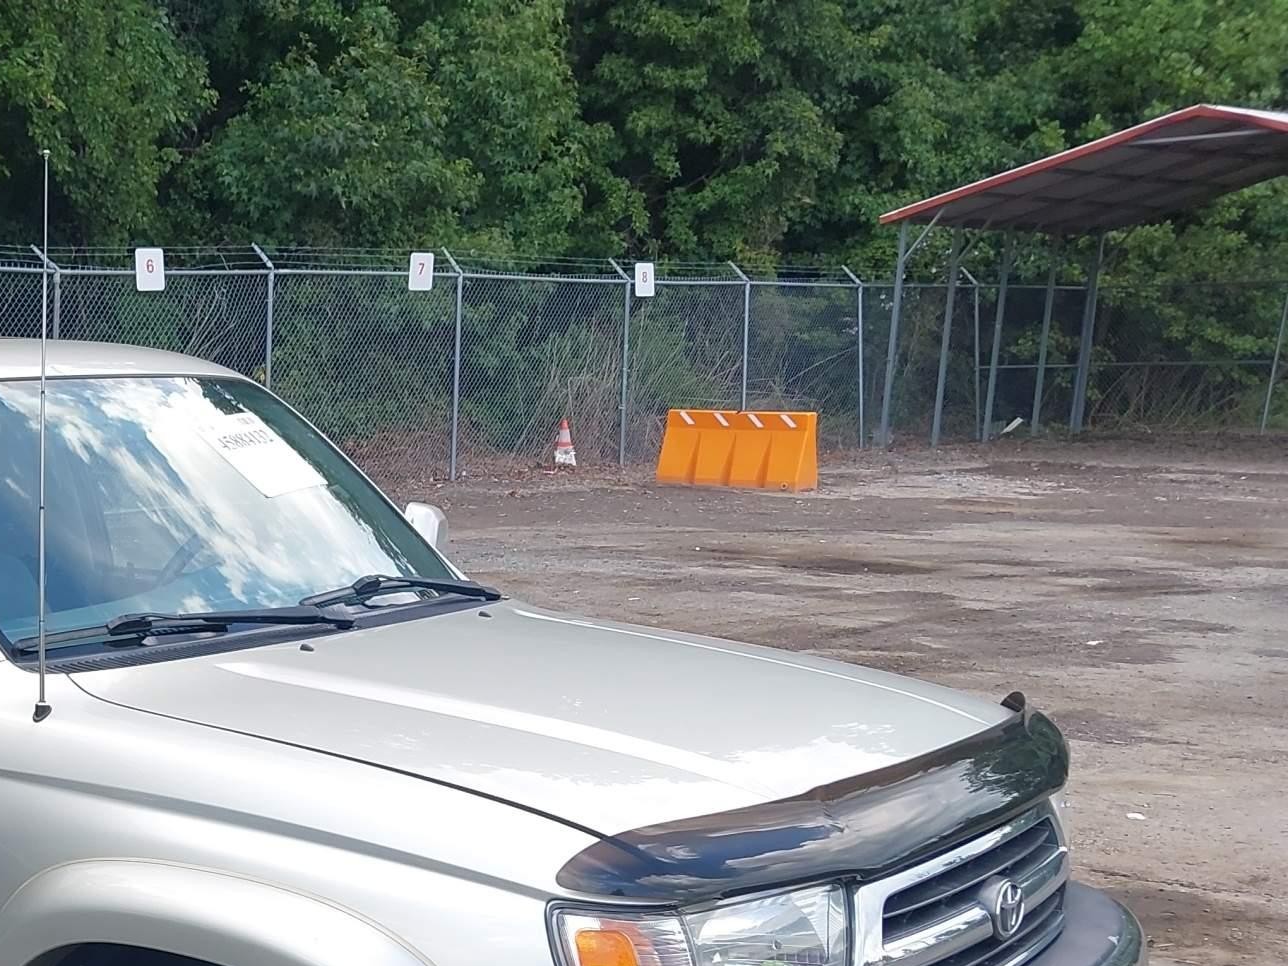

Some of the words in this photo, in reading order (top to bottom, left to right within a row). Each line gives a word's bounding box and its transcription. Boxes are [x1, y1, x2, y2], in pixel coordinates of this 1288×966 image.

[145, 259, 155, 273] 6
[418, 262, 425, 275] 7
[641, 271, 648, 283] 8
